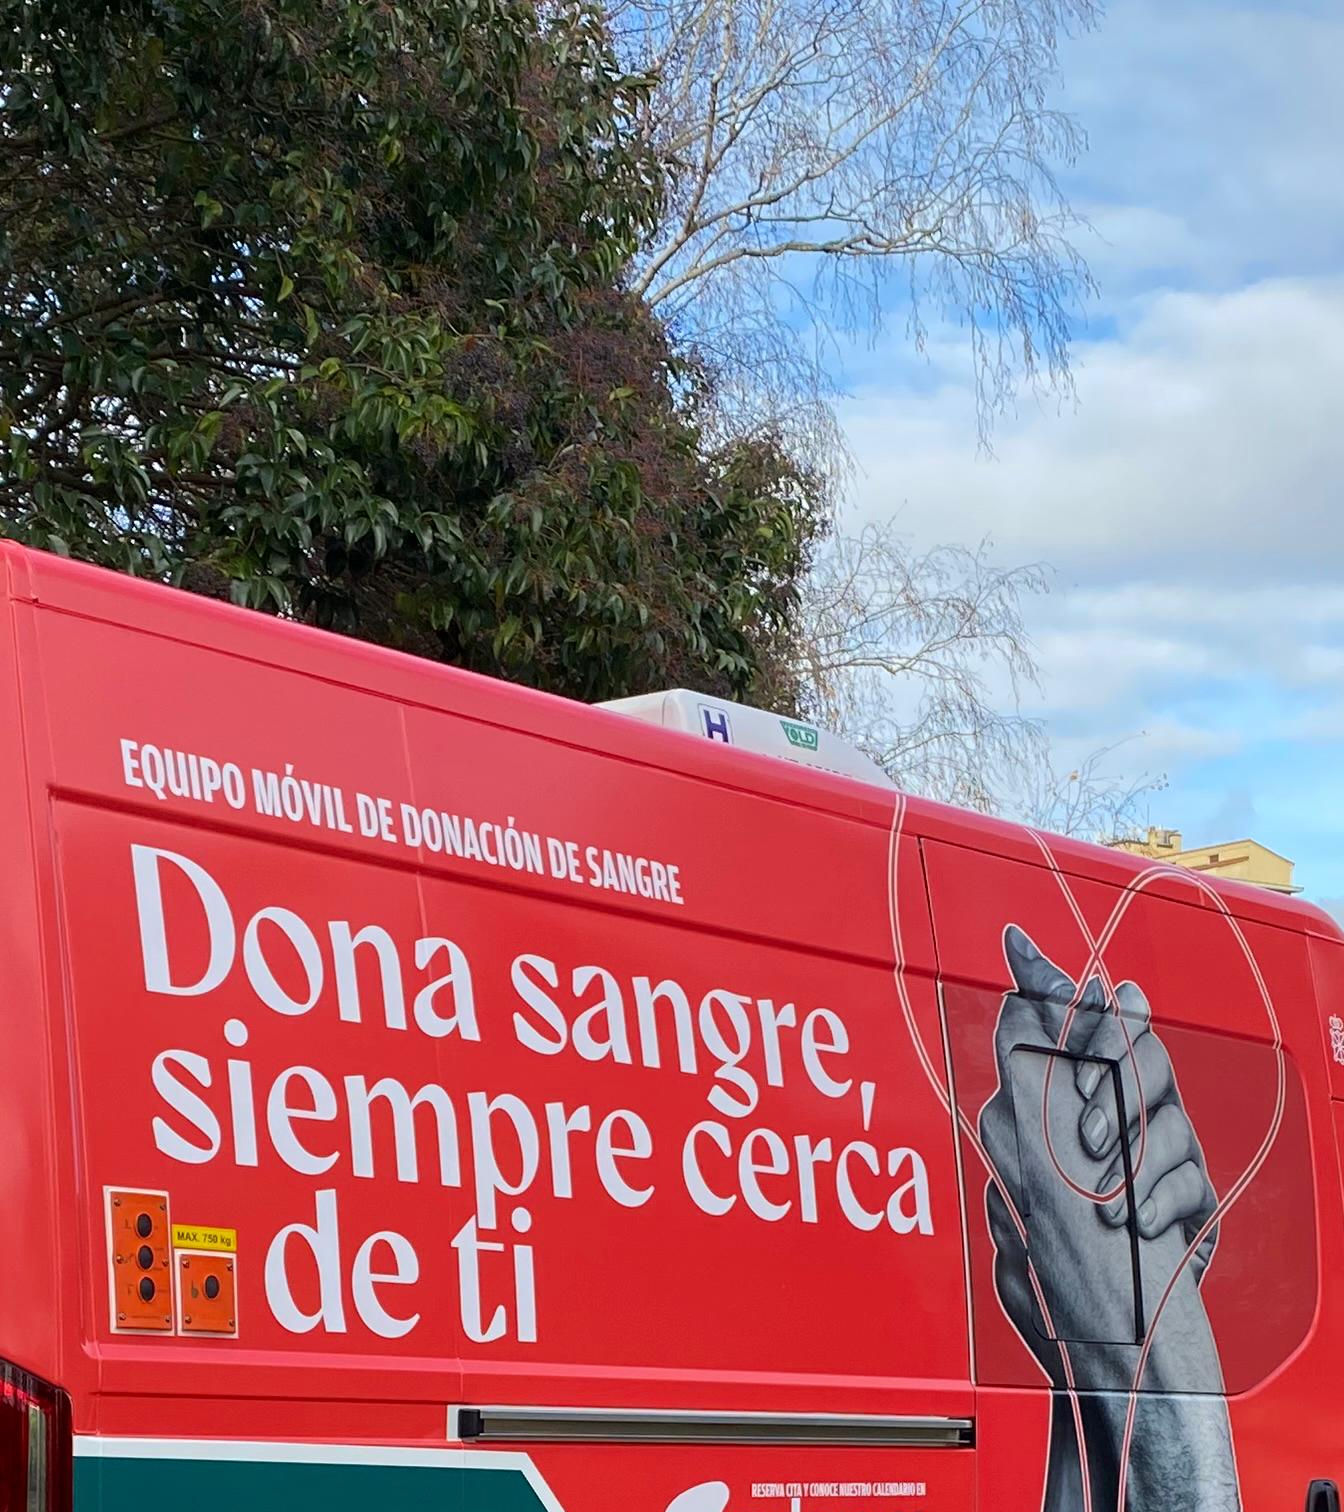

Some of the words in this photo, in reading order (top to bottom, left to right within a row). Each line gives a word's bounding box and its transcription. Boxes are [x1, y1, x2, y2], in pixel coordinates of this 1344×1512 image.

[120, 739, 246, 809] EQUIPO
[253, 764, 353, 834] MÓVIL
[358, 794, 395, 845] DE
[400, 803, 543, 876] DONACIÓN
[547, 834, 582, 881] DE
[585, 847, 685, 905] SANGRE
[130, 843, 482, 1042] Dona
[510, 952, 876, 1132] sangre,
[150, 1018, 657, 1230] siempre
[682, 1119, 937, 1236] cerca
[177, 1231, 200, 1243] MAX.
[202, 1233, 218, 1244] 750
[220, 1233, 232, 1247] kg
[263, 1188, 421, 1340] de
[449, 1205, 538, 1344] ti
[751, 1482, 785, 1498] RESERVA
[785, 1482, 802, 1497] CITA
[803, 1482, 809, 1497] Y
